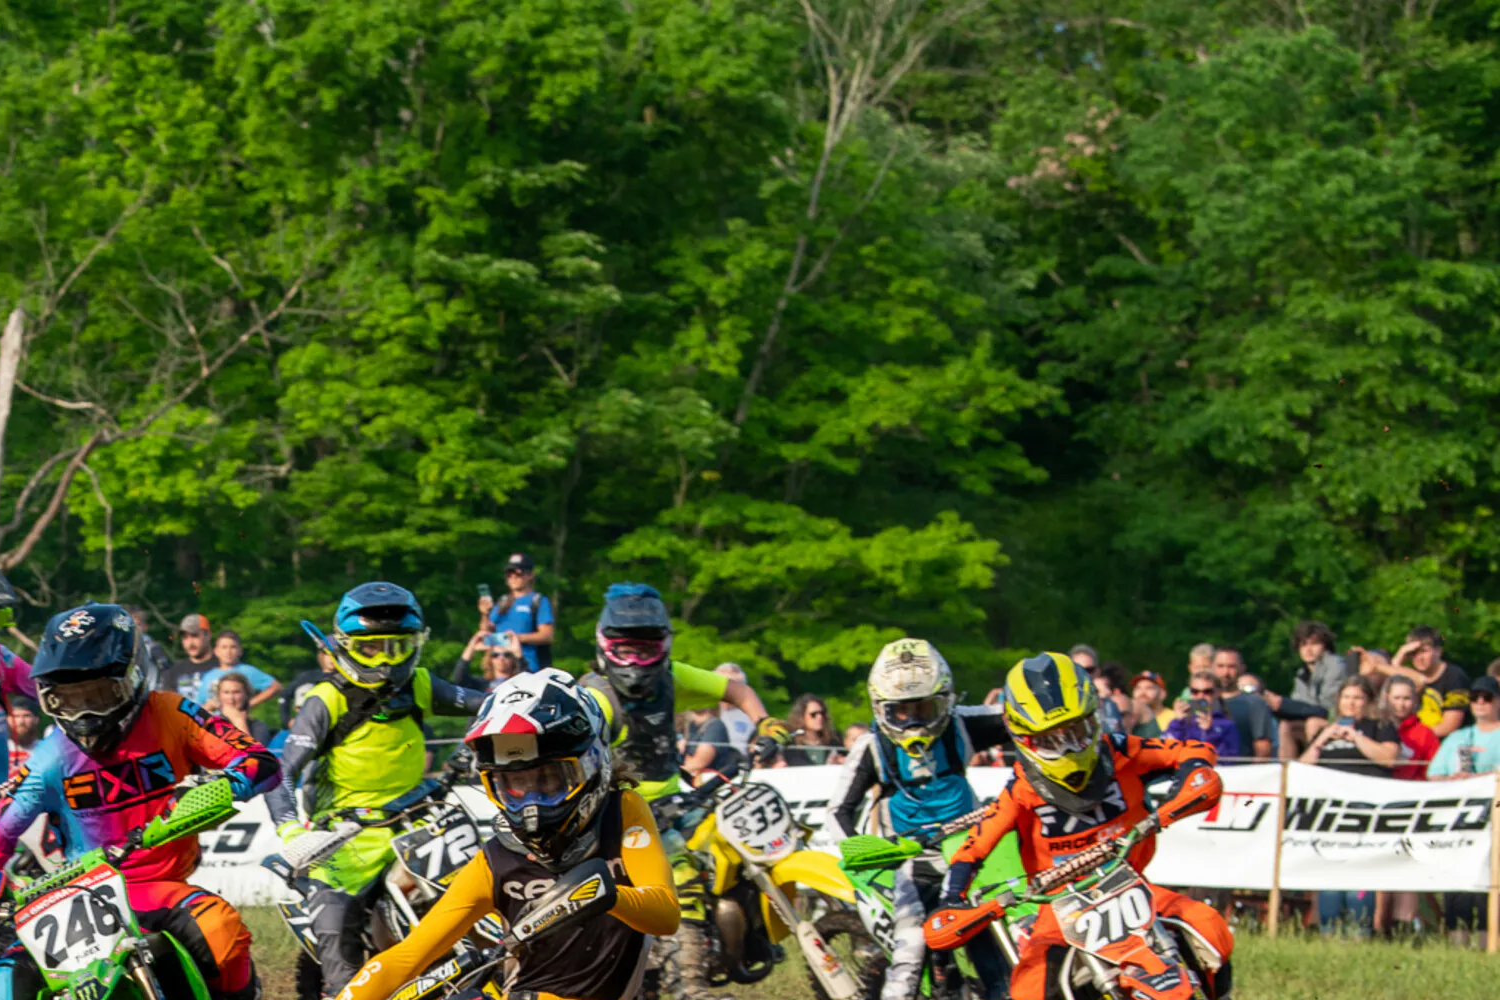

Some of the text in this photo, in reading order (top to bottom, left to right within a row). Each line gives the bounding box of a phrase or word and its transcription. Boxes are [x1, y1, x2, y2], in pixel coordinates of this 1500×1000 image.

[63, 751, 176, 809] FXR
[503, 857, 628, 900] sen
[34, 884, 121, 968] 246
[1075, 887, 1152, 951] 270
